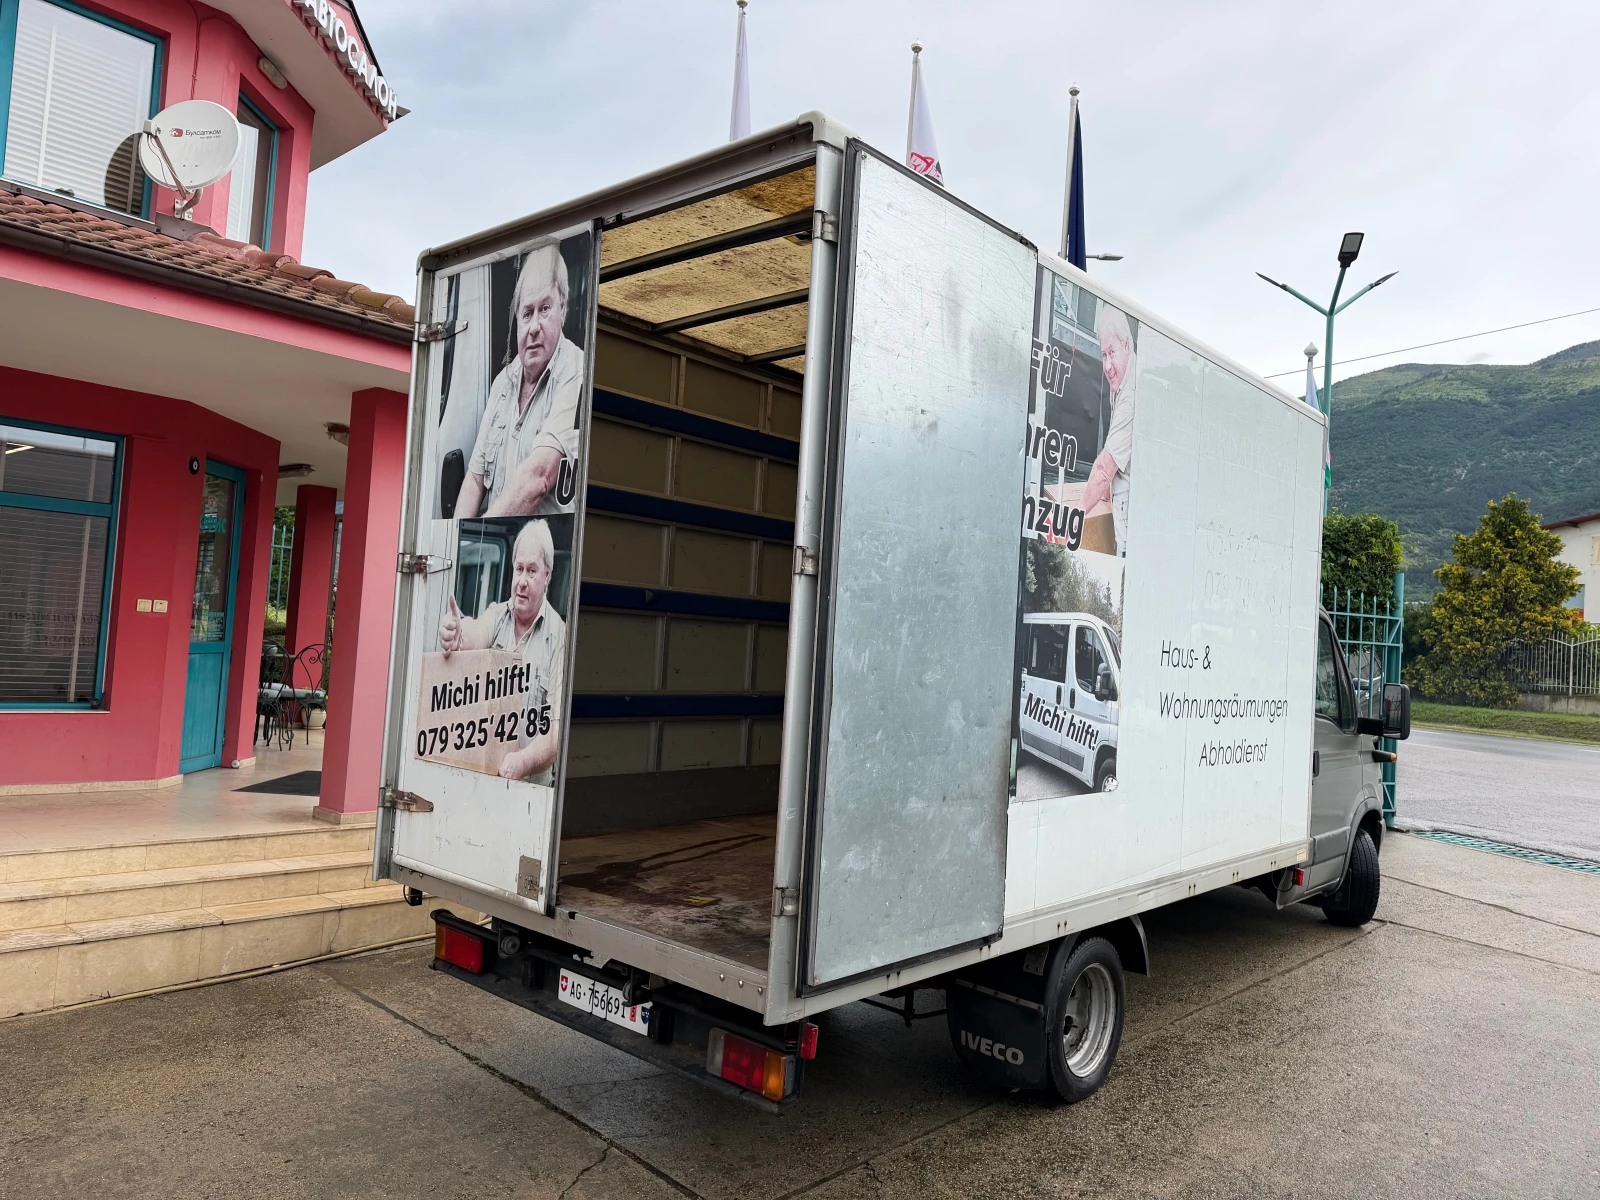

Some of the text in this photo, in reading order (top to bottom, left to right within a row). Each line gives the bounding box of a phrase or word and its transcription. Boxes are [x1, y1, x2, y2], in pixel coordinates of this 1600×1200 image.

[1160, 639, 1212, 670] Haus- &
[431, 663, 531, 712] Michi hilft!
[1023, 692, 1099, 751] Michi hilft!
[1160, 691, 1288, 724] Wohnungsräumungen
[1199, 738, 1268, 767] Abholdienst
[960, 1029, 1025, 1066] IVECO
